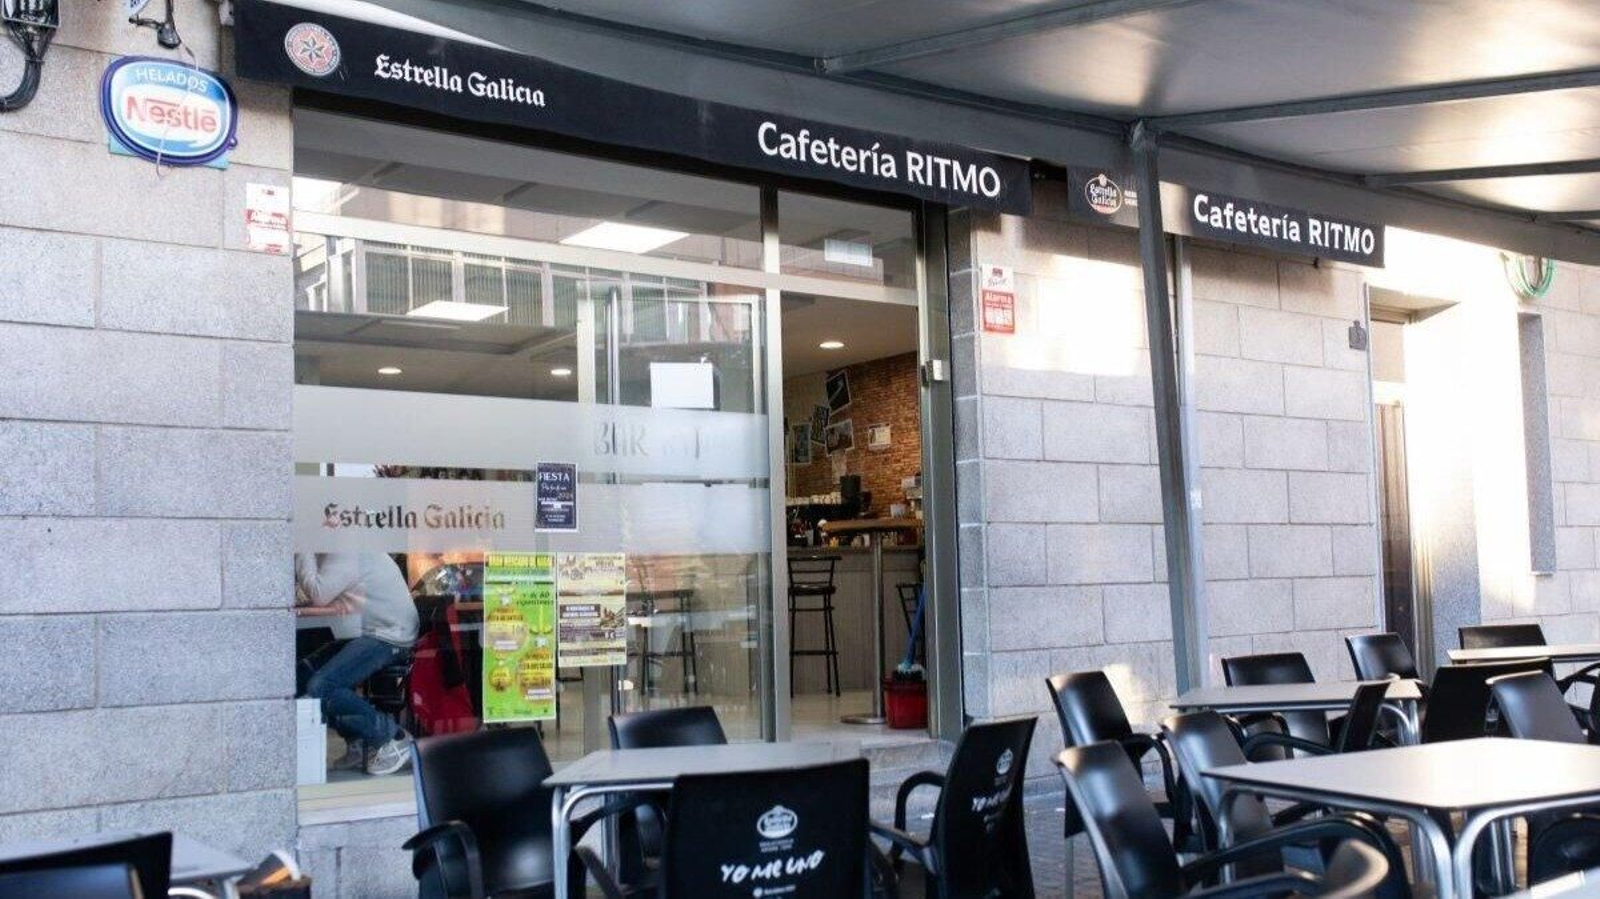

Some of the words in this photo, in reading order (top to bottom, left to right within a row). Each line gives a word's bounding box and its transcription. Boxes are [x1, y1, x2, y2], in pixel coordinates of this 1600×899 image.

[136, 68, 208, 93] HELADOS
[374, 53, 463, 93] Estrella
[467, 72, 546, 107] Galicia
[758, 121, 898, 179] Cafetería
[906, 150, 1000, 198] RITMO
[1193, 194, 1301, 242] Cafetería
[1308, 218, 1375, 255] RITMO
[539, 471, 570, 482] FIESTA
[322, 502, 417, 529] Estrella
[424, 503, 506, 529] Galicia
[720, 864, 750, 883] YO
[785, 849, 825, 875] UNO
